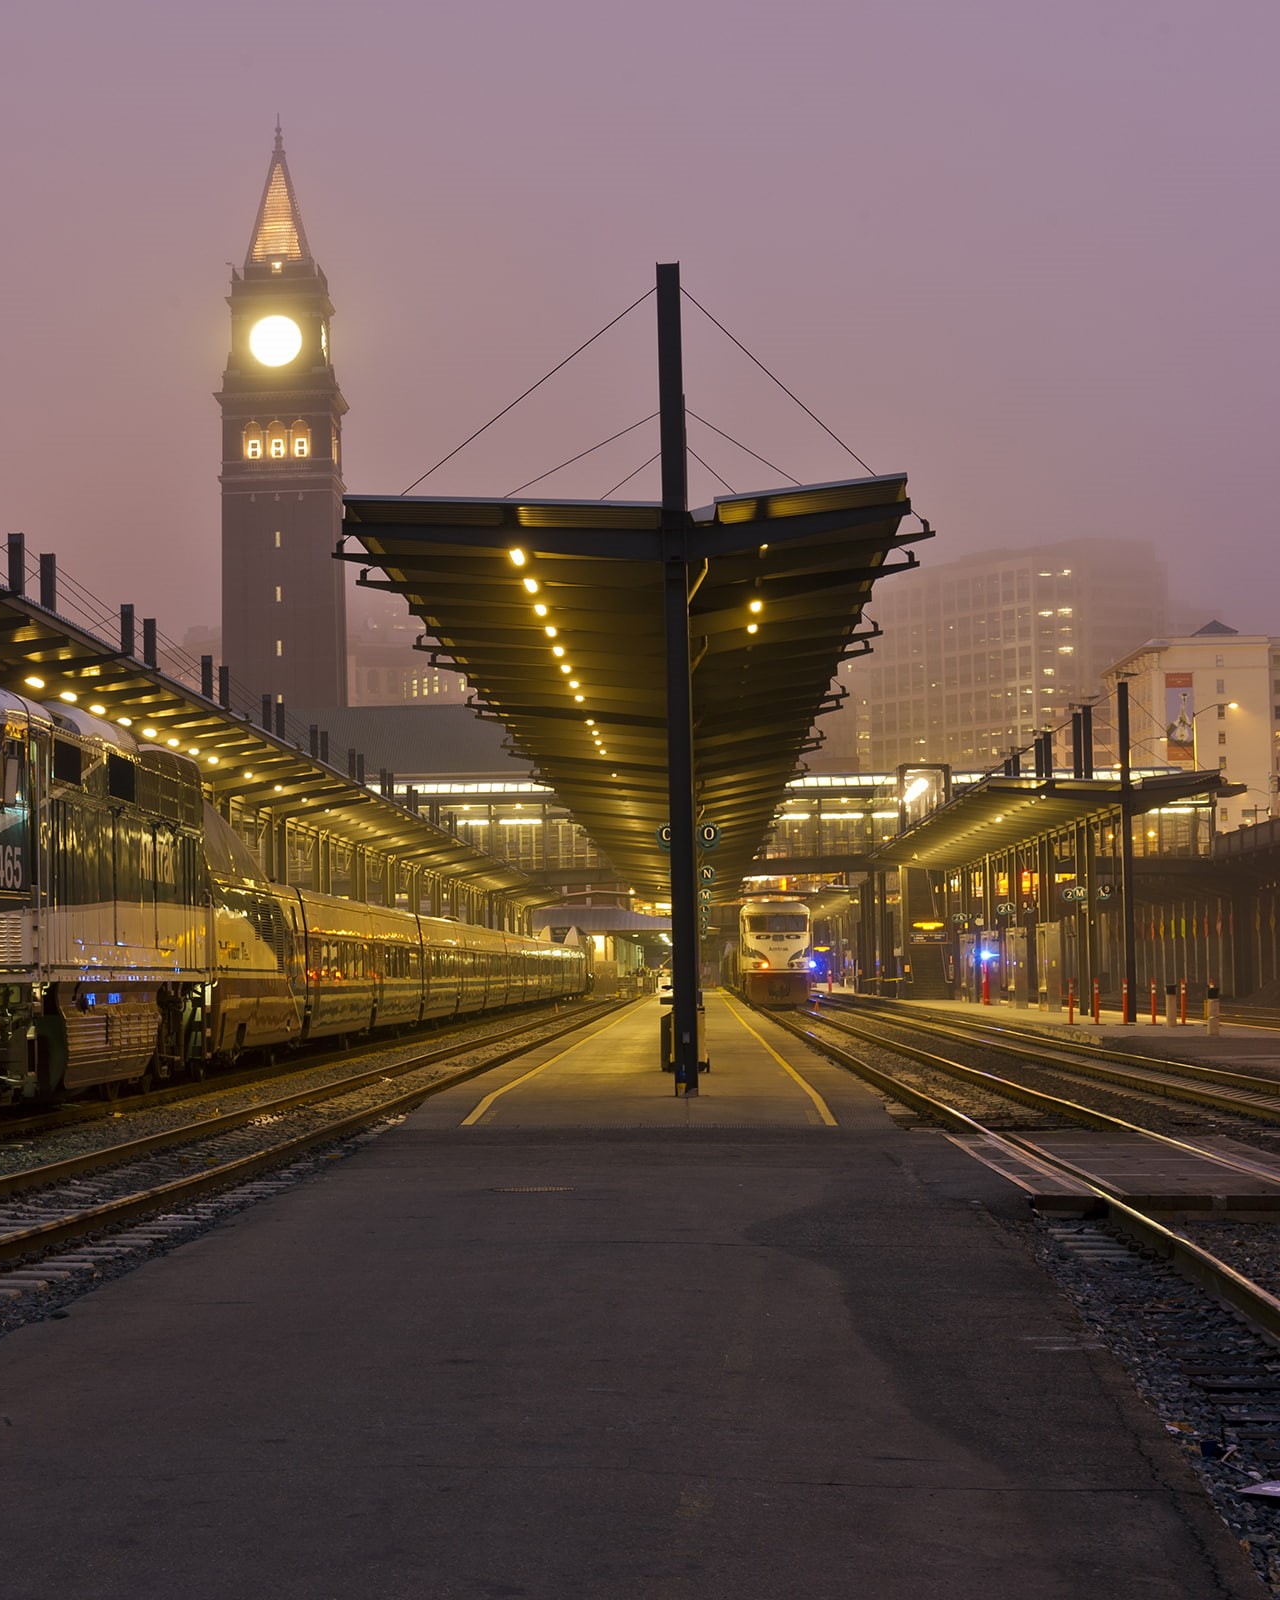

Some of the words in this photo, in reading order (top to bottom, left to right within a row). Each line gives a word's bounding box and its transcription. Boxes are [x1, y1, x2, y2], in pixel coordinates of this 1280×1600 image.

[703, 869, 711, 879] N
[1066, 891, 1072, 899] 2
[1075, 889, 1084, 897] M
